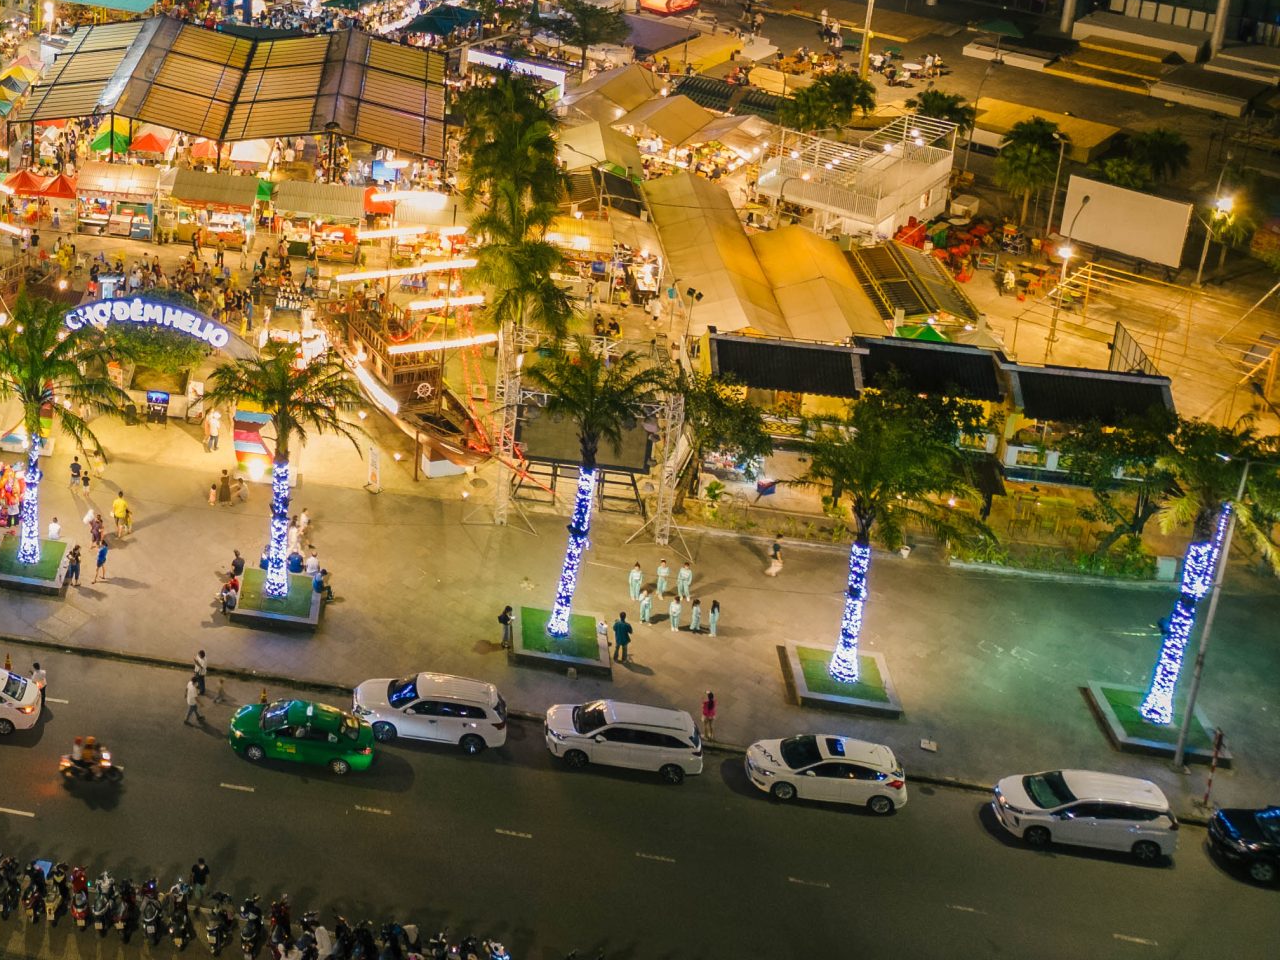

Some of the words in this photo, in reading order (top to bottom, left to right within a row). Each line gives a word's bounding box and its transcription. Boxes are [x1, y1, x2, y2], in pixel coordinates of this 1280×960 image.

[66, 301, 112, 330] CHỢ
[112, 298, 163, 324] ĐÊM
[164, 307, 228, 347] HELIO
